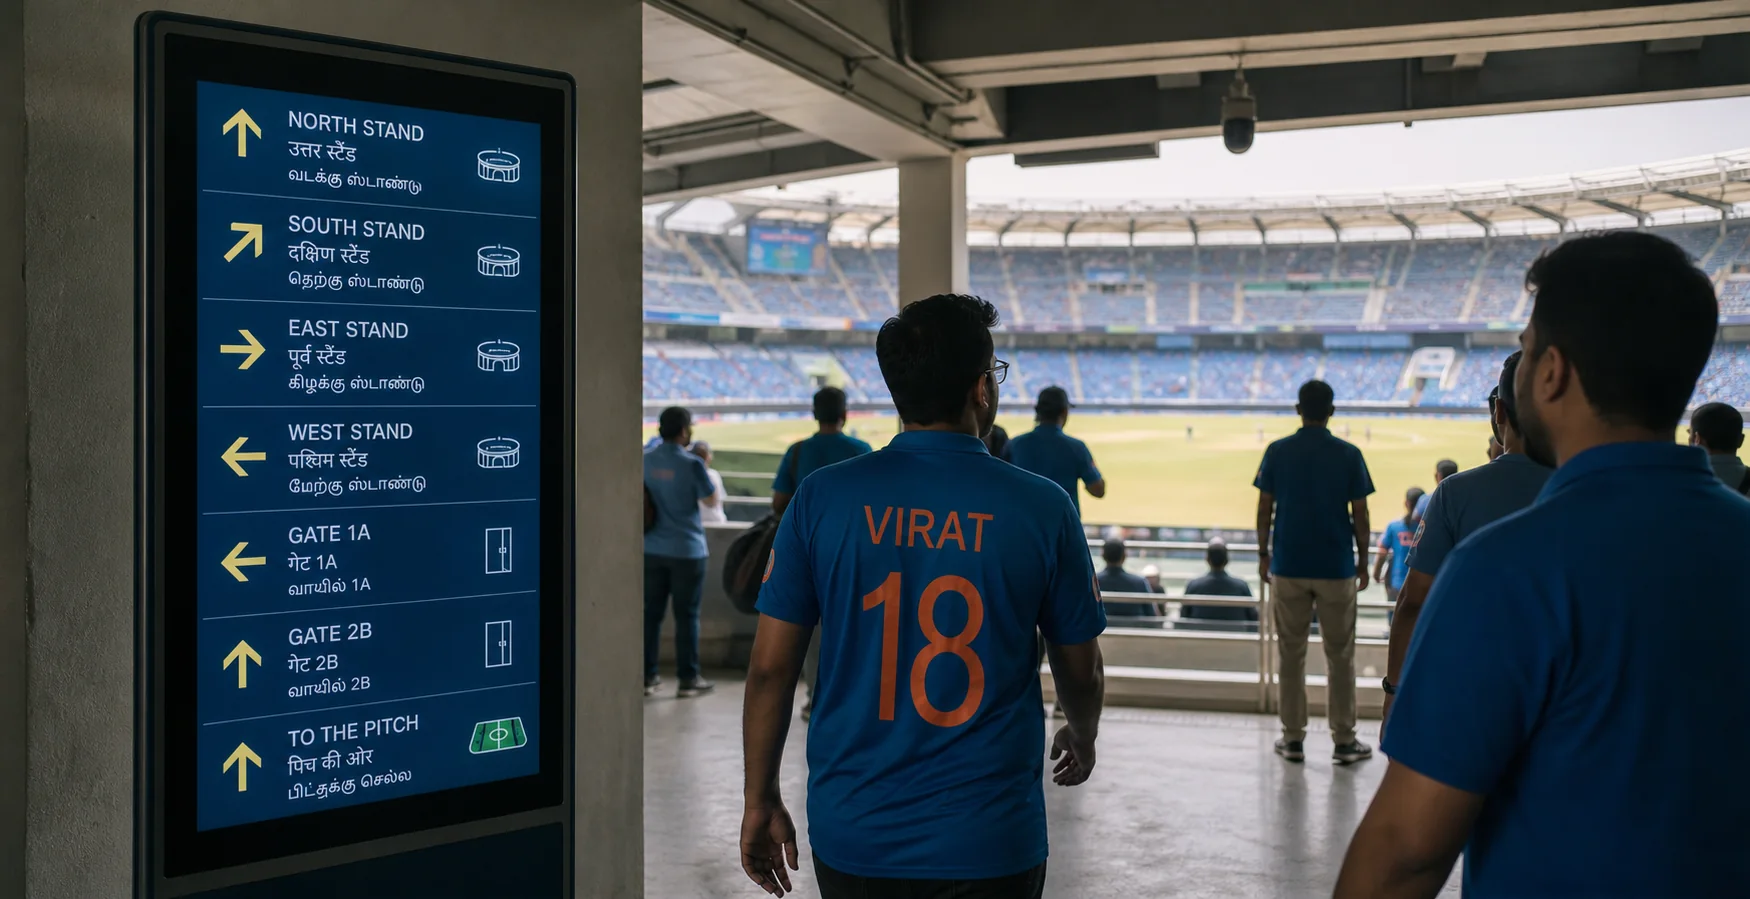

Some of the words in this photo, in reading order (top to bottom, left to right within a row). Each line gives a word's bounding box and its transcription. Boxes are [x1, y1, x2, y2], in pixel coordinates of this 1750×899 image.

[288, 110, 357, 135] NORTH
[363, 119, 424, 142] STAND
[288, 141, 322, 160] उत्तर
[288, 168, 343, 189] வடக்கு
[347, 171, 422, 195] ஸ்டாண்டு
[288, 214, 357, 237] SOUTH
[362, 220, 425, 241] STAND
[288, 240, 336, 263] दक्षिण
[288, 270, 343, 291] தெற்கு
[347, 273, 425, 294] ஸ்டாண்டு
[289, 319, 340, 337] EAST
[346, 321, 409, 339] STAND
[287, 344, 313, 370] पूर्व
[288, 373, 346, 395] கிழக்கு
[350, 375, 425, 394] ஸ்டாண்டு
[288, 423, 345, 441] WEST
[350, 422, 413, 440] STAND
[287, 448, 335, 469] पश्चिम
[288, 477, 343, 497] மேற்கு
[348, 474, 426, 493] ஸ்டாண்டு
[288, 525, 341, 544] GATE
[347, 523, 371, 541] 1A
[864, 505, 994, 553] VIRAT
[287, 552, 312, 572] गेट
[316, 554, 338, 570] 1A
[288, 578, 346, 596] வாயில்
[351, 578, 371, 591] 1A
[288, 625, 341, 646] GATE
[347, 622, 372, 641] 2B
[862, 571, 985, 728] 18
[287, 653, 312, 673] गेट
[315, 654, 339, 671] 2B
[288, 678, 346, 698] வாயில்
[351, 676, 371, 691] 2B
[288, 728, 315, 747] TO
[320, 722, 358, 743] THE
[364, 714, 419, 738] PITCH
[287, 755, 318, 776] पिच
[320, 750, 342, 770] की
[345, 746, 374, 766] ओर
[360, 769, 412, 788] செல்ல
